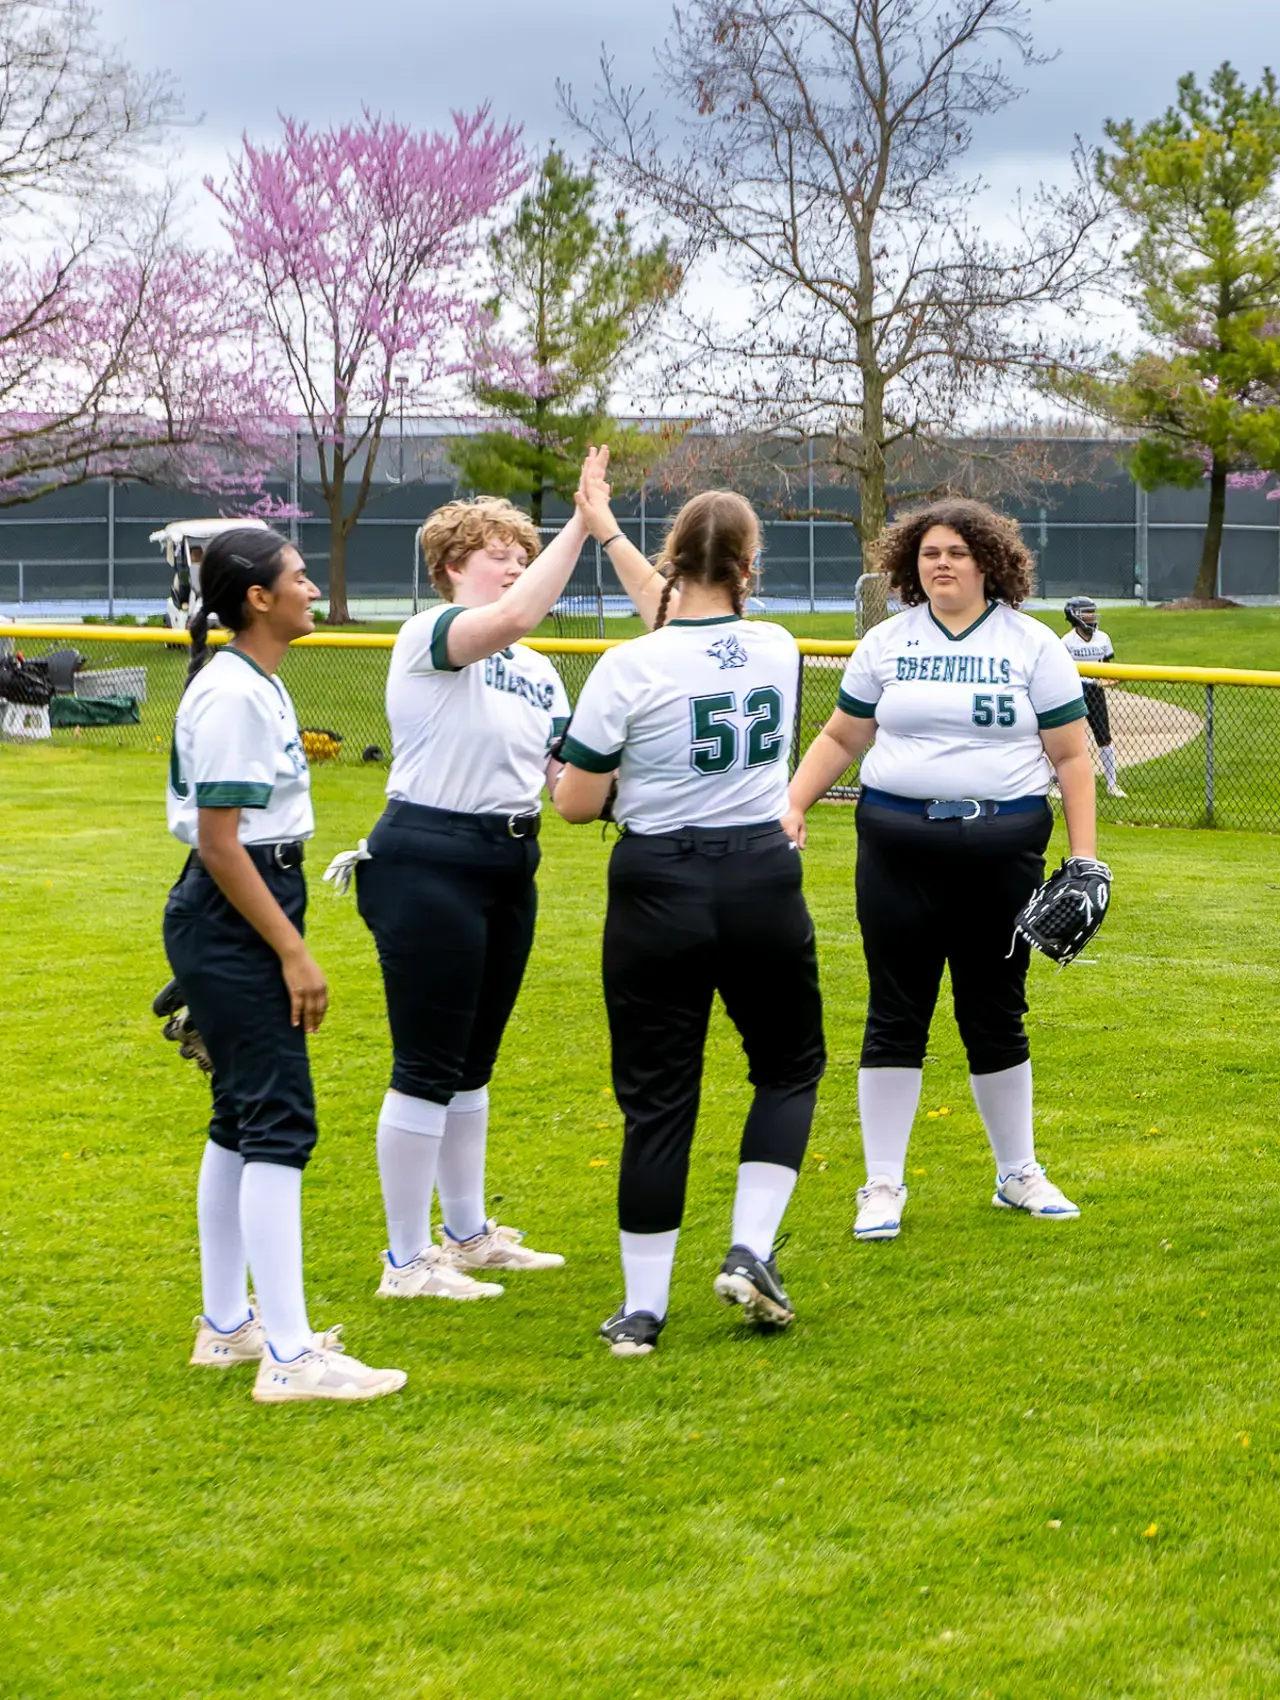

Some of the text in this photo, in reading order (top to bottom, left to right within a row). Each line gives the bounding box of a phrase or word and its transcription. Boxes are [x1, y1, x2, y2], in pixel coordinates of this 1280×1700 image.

[895, 655, 1011, 684] GREENHILLS
[972, 693, 1017, 728] 55
[689, 685, 784, 777] 52
